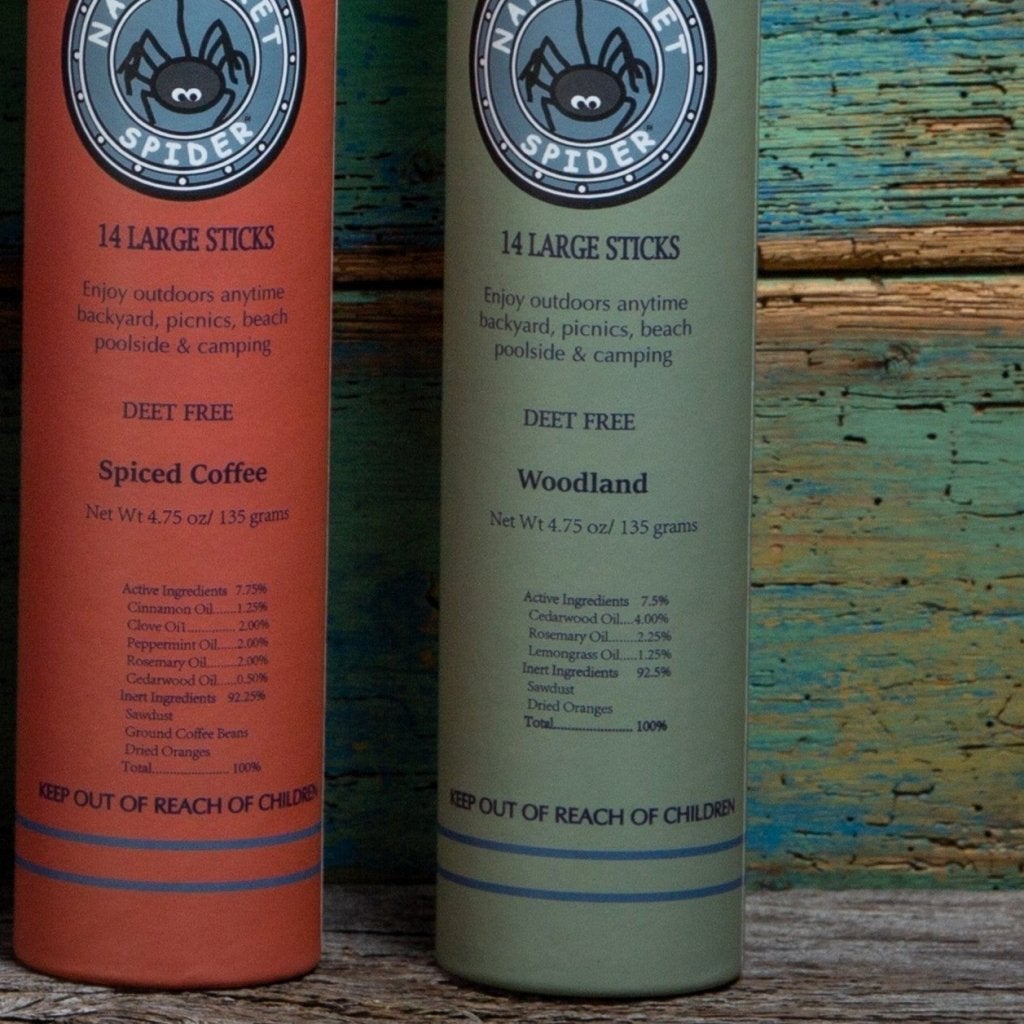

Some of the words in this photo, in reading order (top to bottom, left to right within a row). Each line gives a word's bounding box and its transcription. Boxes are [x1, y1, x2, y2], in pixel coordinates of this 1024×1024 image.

[119, 121, 254, 166] SPIDER
[520, 130, 656, 173] SPIDER
[99, 223, 121, 248] 14
[127, 226, 200, 252] LARGE
[206, 225, 275, 252] STICKS
[502, 230, 523, 256] 14
[528, 232, 600, 260] LARGE
[606, 235, 680, 261] STICKS
[83, 281, 127, 304] Enjoy
[134, 285, 214, 303] outdoors
[221, 285, 285, 306] anytime
[78, 304, 158, 330] backyard,
[167, 312, 236, 333] picnics,
[243, 308, 287, 327] beach
[95, 334, 170, 353] poolside
[177, 337, 191, 354] &
[197, 337, 271, 358] camping
[122, 402, 177, 421] DEET
[183, 404, 233, 421] FREE
[523, 409, 577, 429] DEET
[583, 412, 635, 430] FREE
[99, 460, 182, 487] Spiced
[190, 461, 267, 485] Coffee
[517, 468, 648, 494] Woodland
[125, 726, 172, 739] Ground
[175, 727, 214, 739] Coffee
[217, 728, 248, 739] Beans
[38, 781, 71, 803] KEEP
[73, 789, 115, 810] OUT
[119, 795, 148, 813] OF
[154, 797, 222, 815] REACH
[228, 795, 254, 814] OF
[450, 789, 476, 809] KEEP
[479, 797, 518, 818] OUT
[521, 803, 549, 822] OF
[555, 806, 624, 826] REACH
[630, 808, 659, 826] OF
[663, 797, 736, 824] CHILDREN
